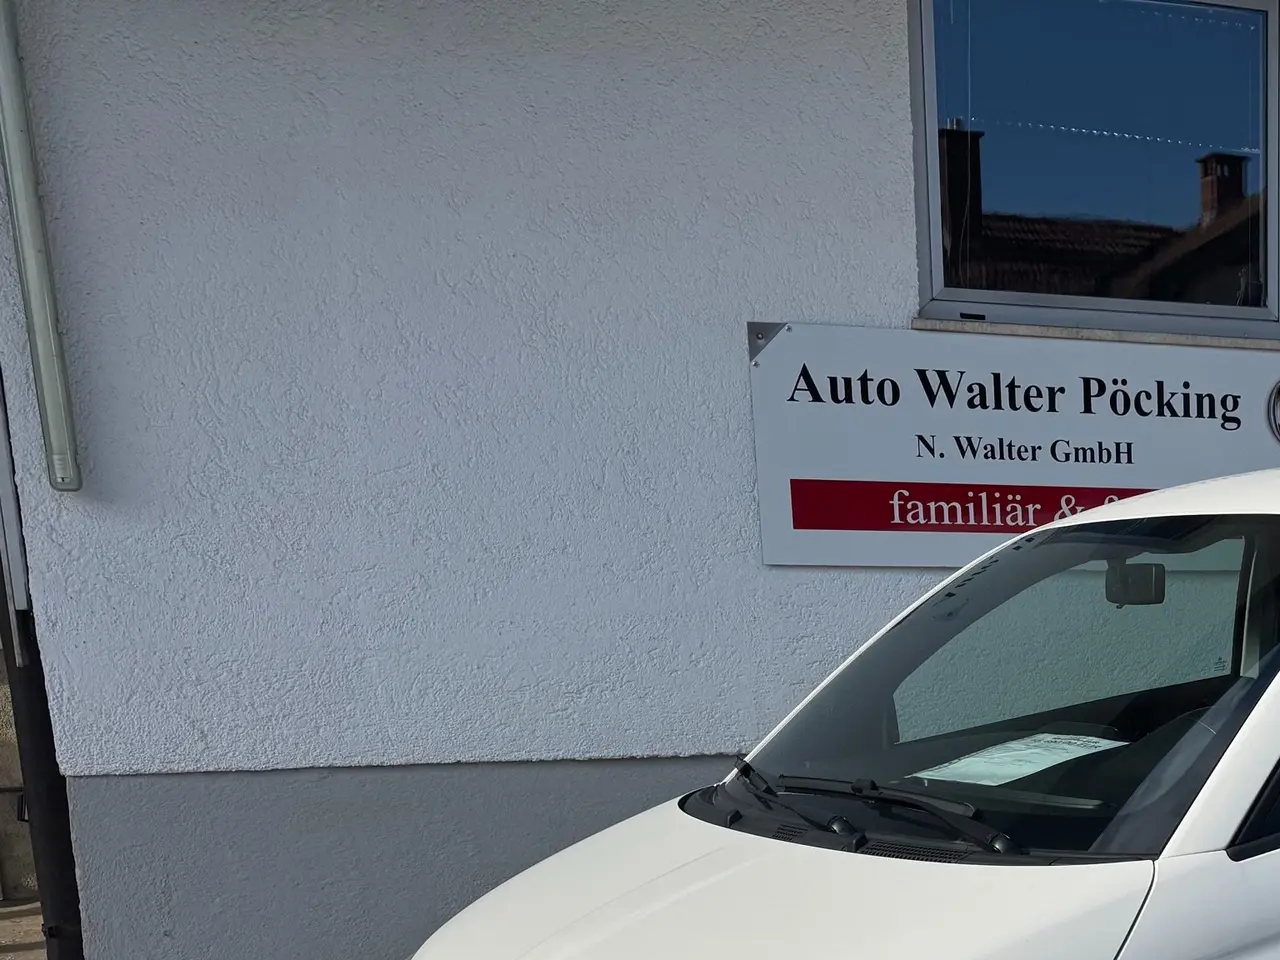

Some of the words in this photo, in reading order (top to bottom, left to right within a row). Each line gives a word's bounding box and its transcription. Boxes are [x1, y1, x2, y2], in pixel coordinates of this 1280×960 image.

[787, 362, 901, 407] Auto
[913, 368, 1066, 412] Walter
[1078, 376, 1242, 431] Pöcking
[915, 434, 945, 459] N.
[953, 435, 1042, 462] Walter
[1050, 439, 1135, 465] GmbH
[889, 489, 1041, 527] familiär
